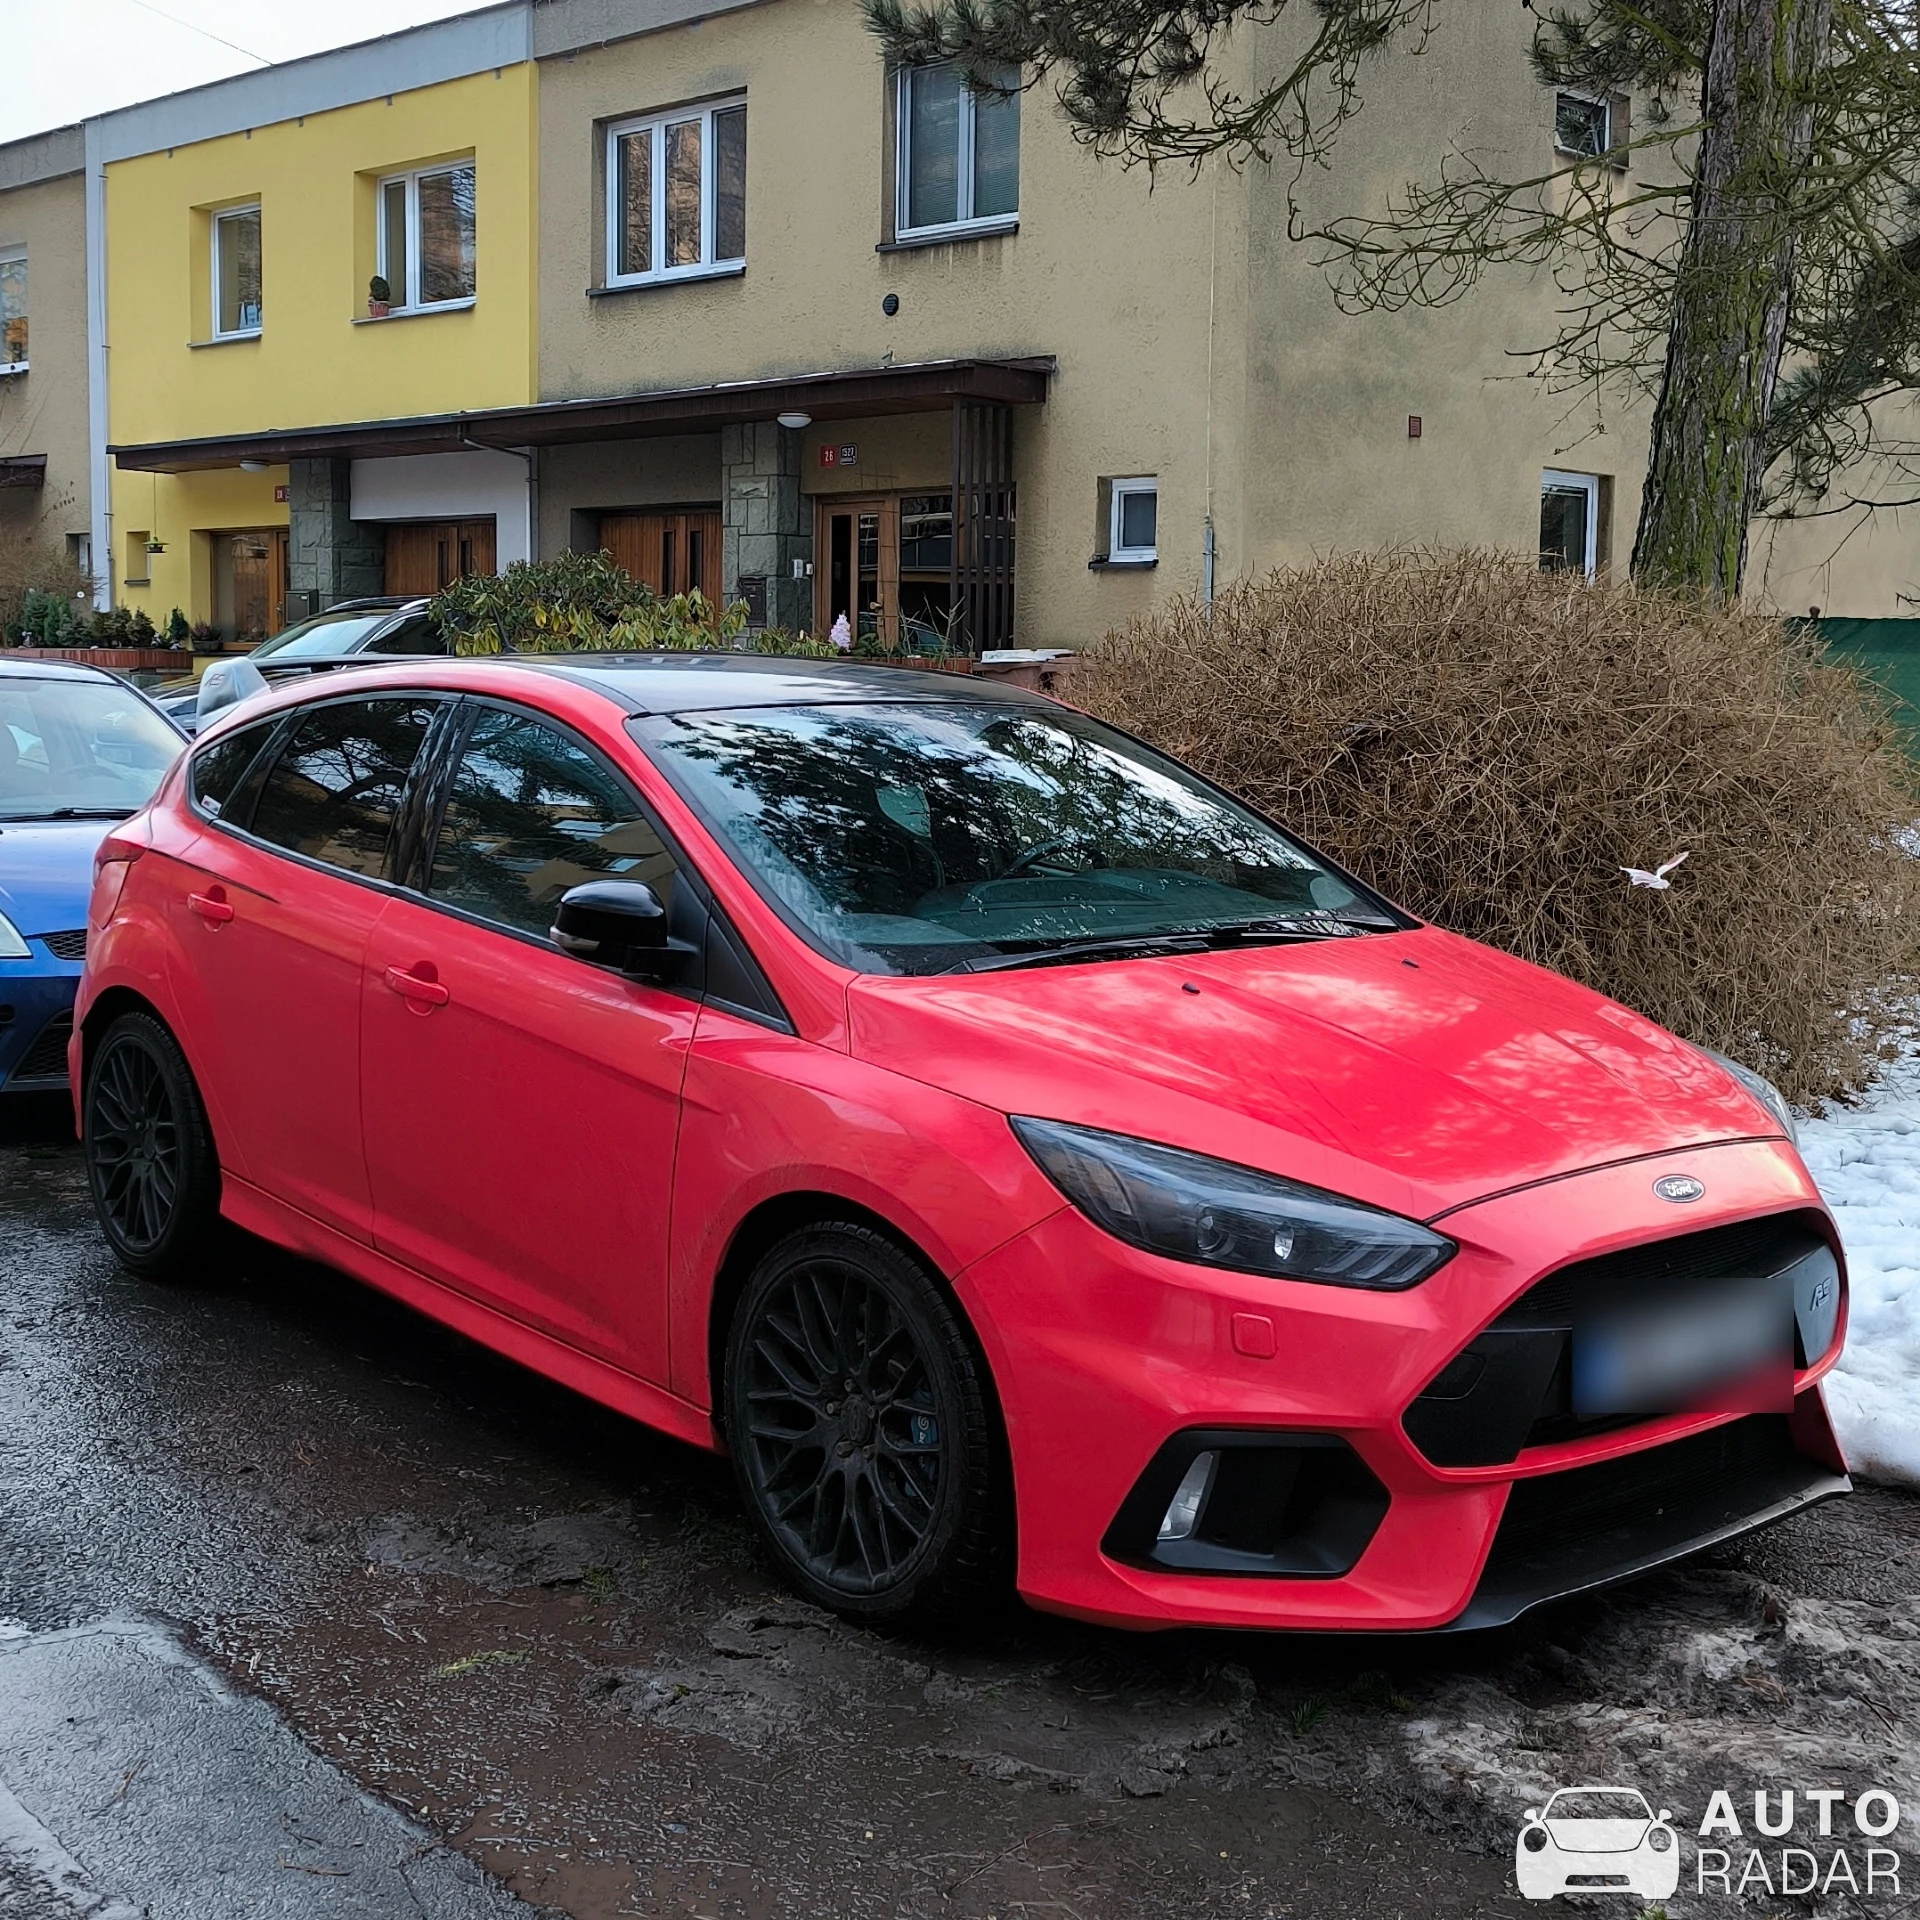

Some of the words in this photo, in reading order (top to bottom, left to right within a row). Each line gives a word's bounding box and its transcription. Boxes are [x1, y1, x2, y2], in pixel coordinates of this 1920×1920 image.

[824, 450, 834, 462] 26
[1664, 1180, 1695, 1197] Ford
[1810, 1276, 1832, 1311] RS
